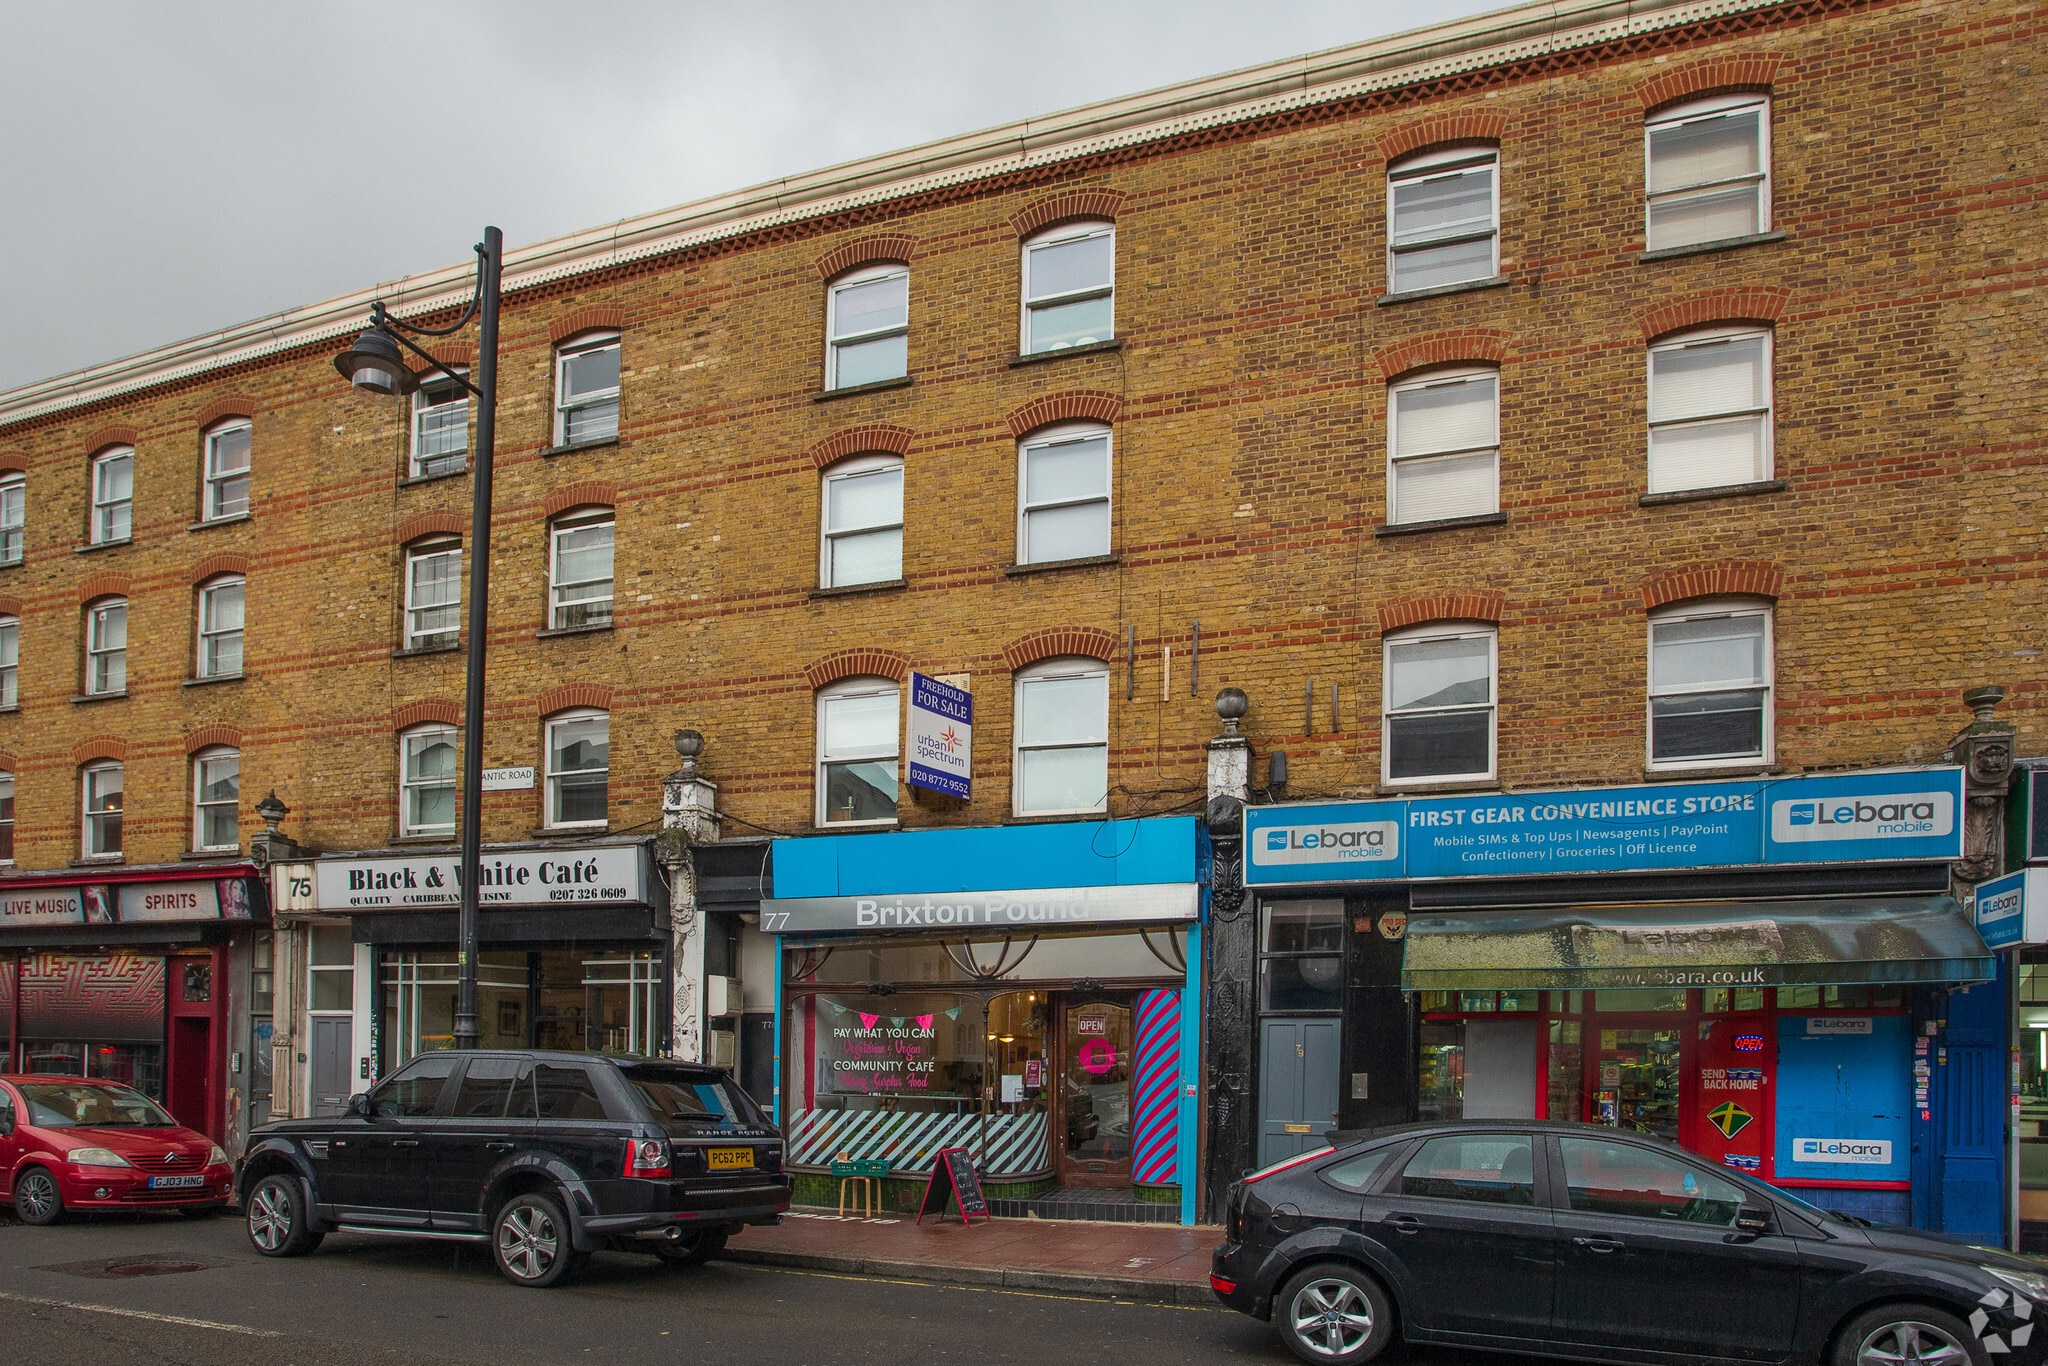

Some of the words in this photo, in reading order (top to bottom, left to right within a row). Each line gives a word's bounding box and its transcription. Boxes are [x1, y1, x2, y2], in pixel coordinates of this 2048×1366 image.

[921, 678, 965, 703] FREEHOLD
[917, 690, 938, 710] FOR
[940, 700, 968, 719] SALE
[917, 733, 947, 752] urban
[917, 745, 965, 768] spectrum
[482, 771, 506, 781] ANTIC
[508, 770, 532, 780] ROAD
[911, 769, 926, 782] 020
[928, 774, 948, 788] 8772
[949, 780, 969, 794] 9552
[1410, 810, 1466, 827] FIRST
[1471, 807, 1525, 824] GEAR
[1531, 798, 1677, 821] CONVENIENCE
[1683, 795, 1755, 814] STORE
[1818, 801, 1934, 824] Lebara
[1434, 835, 1475, 847] Mobile
[1478, 834, 1508, 845] SIMs
[1511, 834, 1521, 843] &
[1524, 832, 1546, 845] Top
[1549, 831, 1572, 844] Ups
[1583, 827, 1660, 840] Newsagents
[1671, 824, 1729, 838] PayPoint
[1877, 821, 1933, 833] mobile
[1291, 829, 1384, 850] Lebara
[1338, 847, 1383, 859] mobile
[1461, 848, 1546, 862] Confectionery
[1556, 846, 1616, 858] Groceries
[1626, 844, 1645, 855] Off
[1649, 842, 1697, 854] Licence
[348, 867, 418, 890] Black
[425, 866, 445, 889] &
[538, 857, 599, 885] Café
[289, 877, 312, 897] 75
[550, 890, 575, 901] 0207
[577, 889, 598, 900] 326
[600, 887, 627, 899] 0609
[4, 900, 31, 916] LIVE
[36, 898, 77, 914] MUSIC
[145, 893, 197, 910] SPIRITS
[350, 896, 392, 906] QUALITY
[403, 894, 461, 904] CARIBBEAN
[480, 892, 512, 901] UISINE
[856, 898, 974, 926] Brixton
[985, 889, 1089, 922] Pound
[1989, 895, 2017, 912] Lebara
[764, 912, 790, 930] 77
[1080, 1021, 1103, 1031] OPEN
[1824, 1020, 1866, 1028] Lebara
[834, 1028, 851, 1038] PAY
[853, 1028, 882, 1039] WHAT
[885, 1028, 909, 1039] YOU
[911, 1028, 935, 1039] CAN
[843, 1040, 885, 1059] Vegetarian
[895, 1040, 921, 1060] Vegan
[1295, 1044, 1304, 1057] 79
[1735, 1039, 1764, 1049] OPEN
[834, 1060, 903, 1072] COMMUNITY
[907, 1057, 935, 1072] CAFÉ
[906, 1073, 929, 1088] Food
[1701, 1069, 1725, 1079] SEND
[1704, 1080, 1728, 1090] BACK
[1729, 1080, 1758, 1090] HOME
[1819, 1141, 1882, 1155] Lebara
[712, 1152, 734, 1164] PC62
[735, 1152, 751, 1163] PPC
[155, 1177, 181, 1187] GJ03
[183, 1176, 203, 1186] HNG
